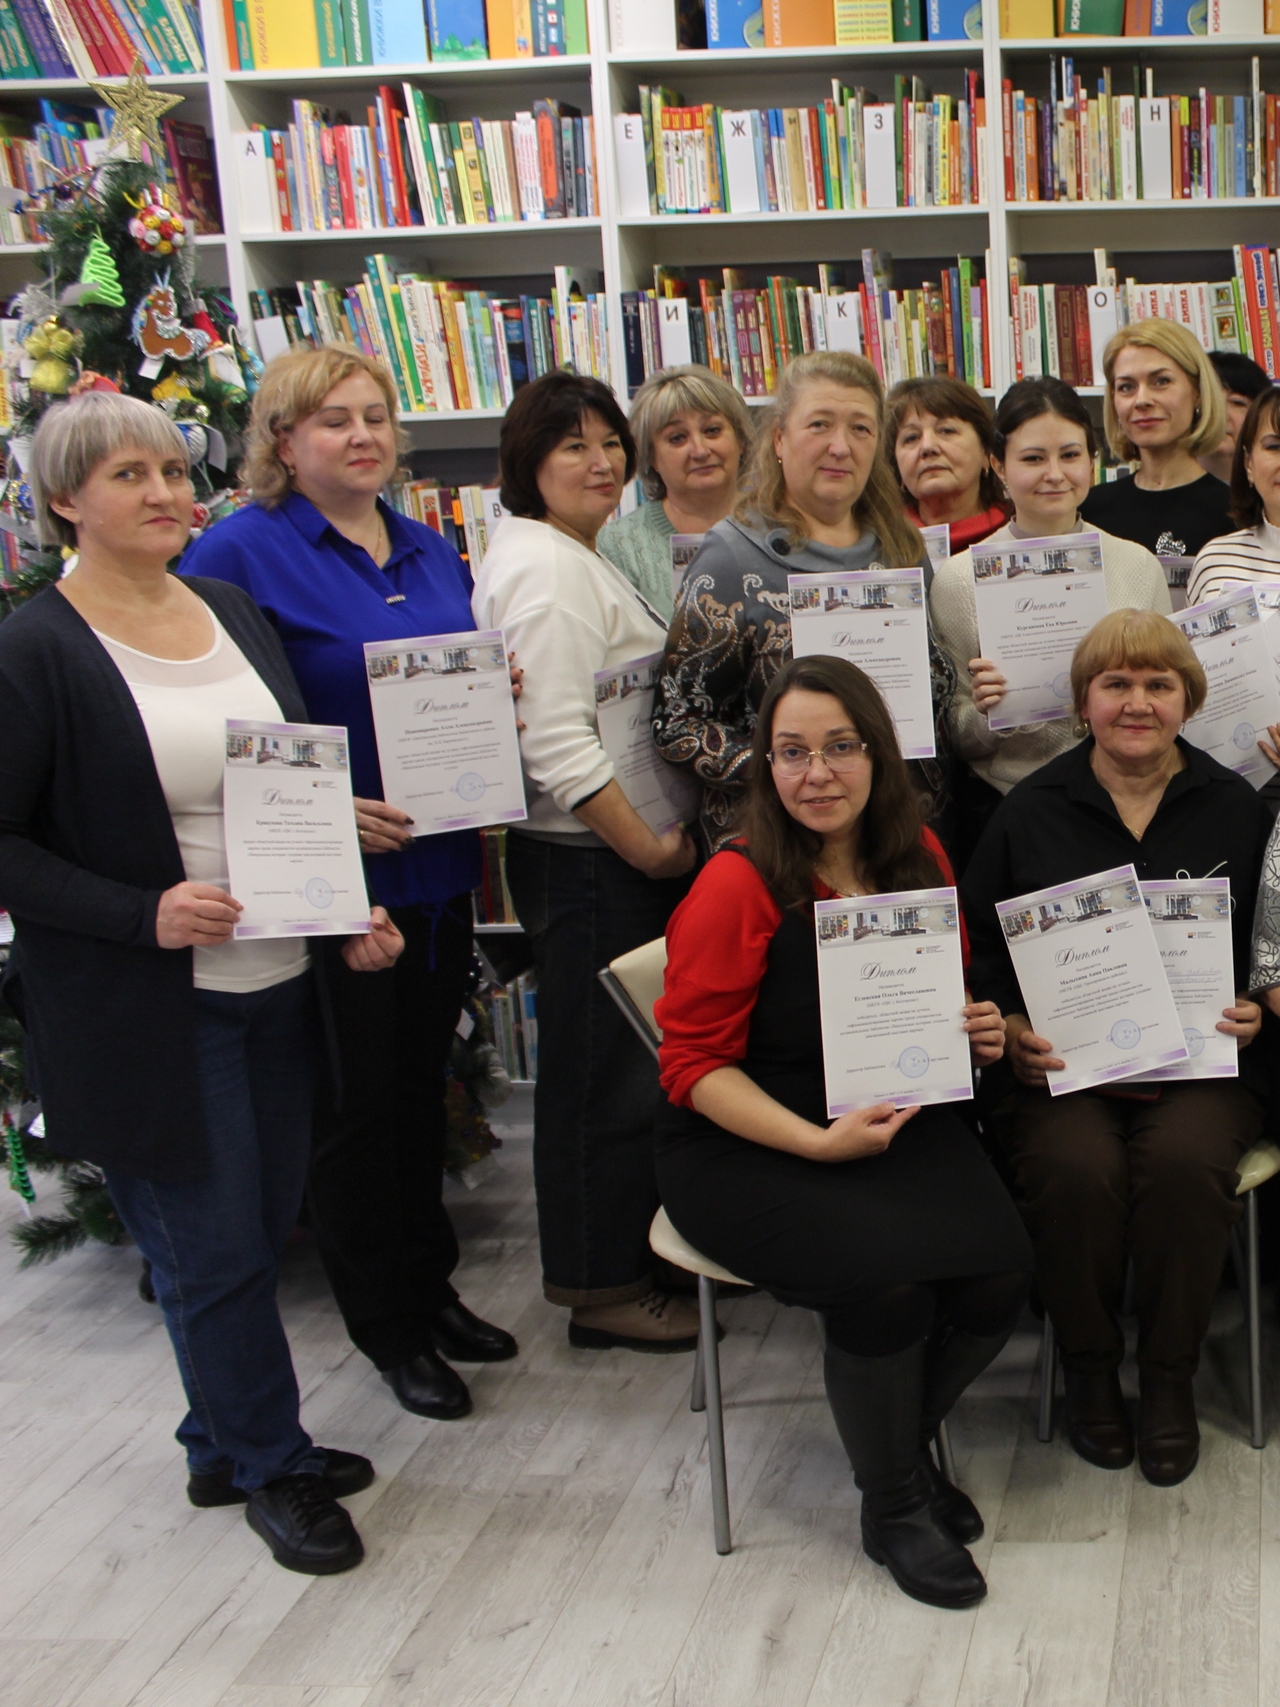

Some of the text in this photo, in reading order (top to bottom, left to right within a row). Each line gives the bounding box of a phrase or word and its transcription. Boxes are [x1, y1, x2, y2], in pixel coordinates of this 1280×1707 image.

[1149, 105, 1161, 121] Н
[623, 122, 634, 140] Е
[729, 120, 747, 137] Ж
[245, 140, 257, 157] А
[1094, 291, 1107, 308] О
[1149, 289, 1159, 317] ИНКА
[664, 305, 679, 322] И
[835, 300, 848, 318] К
[1259, 308, 1273, 348] БОЛЬШАЯ
[1265, 348, 1273, 370] ОСТЕР
[492, 503, 502, 518] В
[1014, 597, 1067, 615] Диплом
[830, 631, 886, 648] Диплом
[413, 698, 470, 715] Диплом
[1054, 944, 1112, 969] Диплом
[859, 962, 918, 982] Диплом
